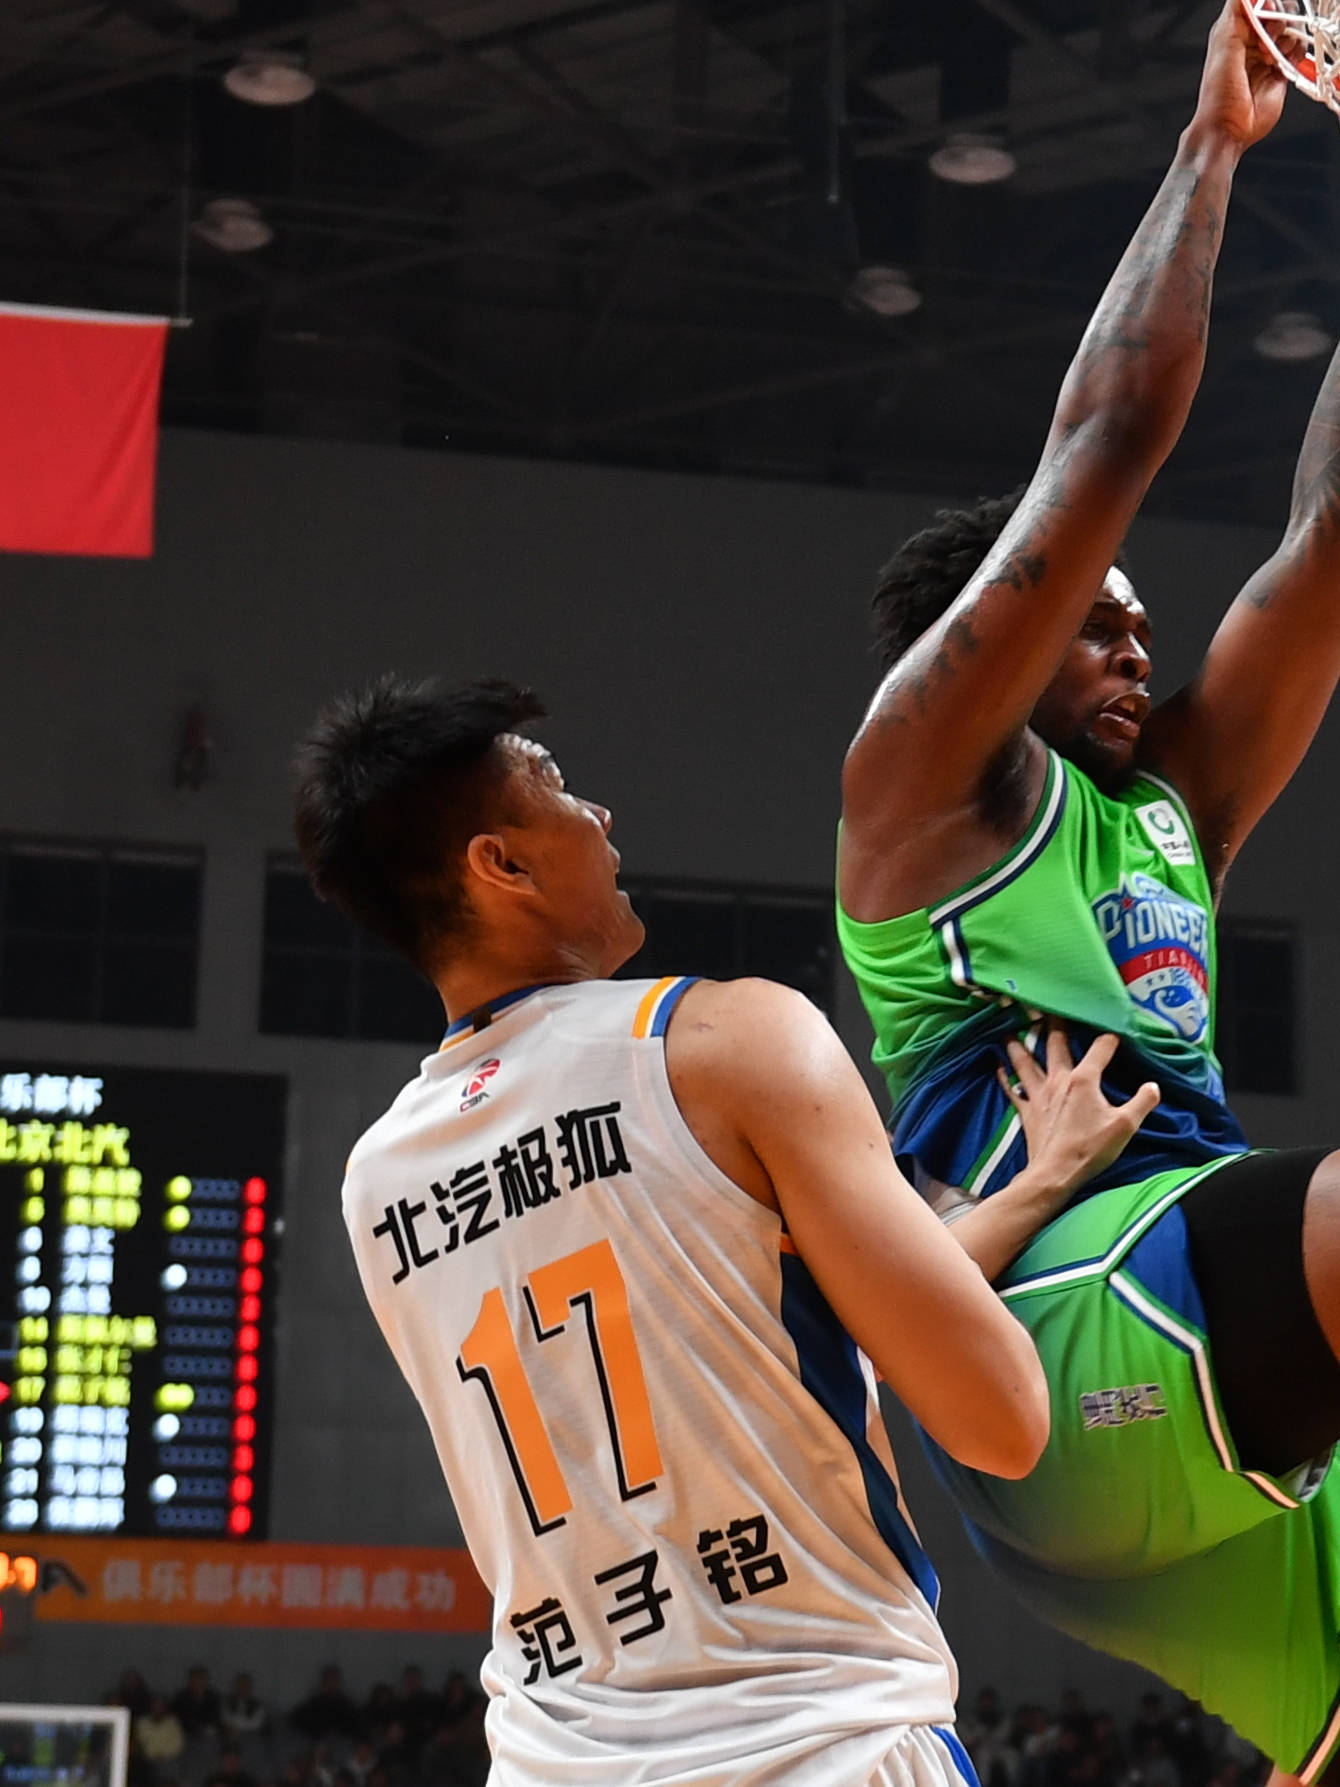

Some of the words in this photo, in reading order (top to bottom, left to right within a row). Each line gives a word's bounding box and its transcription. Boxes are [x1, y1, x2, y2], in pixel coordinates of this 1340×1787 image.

[372, 1102, 633, 1285] 北汽极狐
[454, 1237, 664, 1537] 17
[508, 1514, 790, 1686] 范子铭
